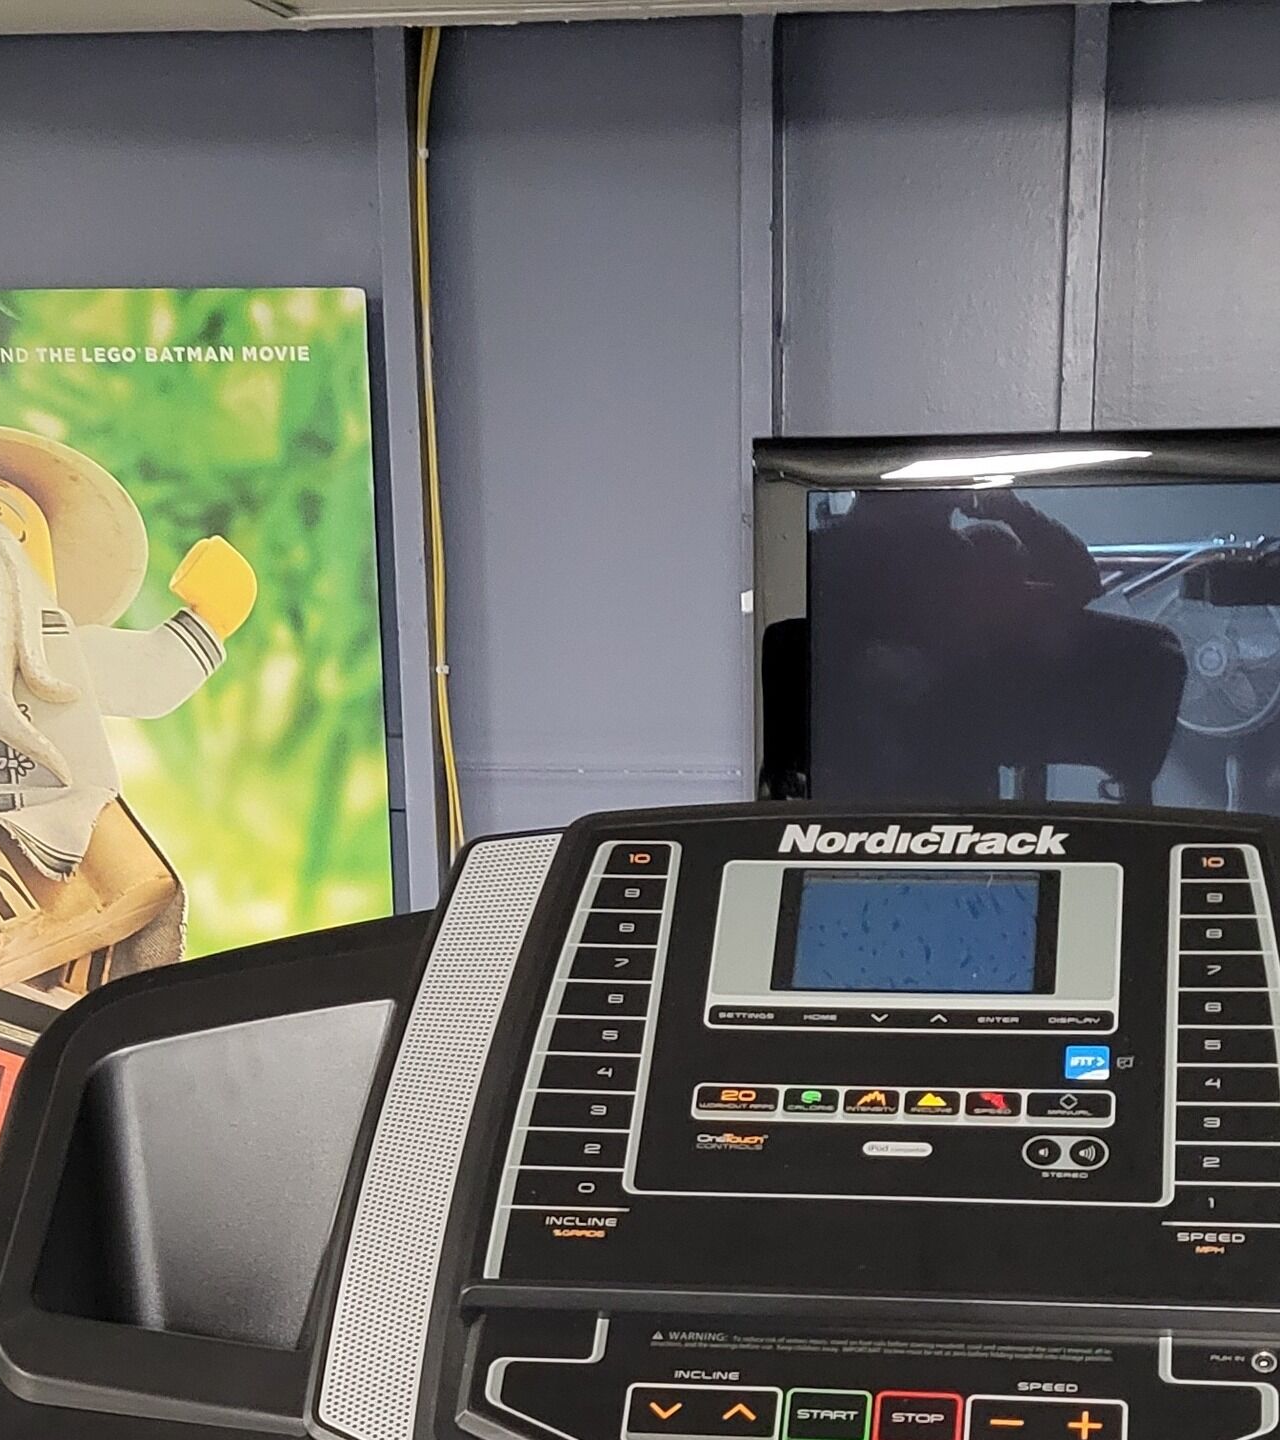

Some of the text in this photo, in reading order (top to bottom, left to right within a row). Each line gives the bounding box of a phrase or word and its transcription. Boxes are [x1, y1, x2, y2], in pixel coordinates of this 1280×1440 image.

[35, 347, 76, 364] THE
[145, 346, 235, 363] BATMAN
[241, 345, 310, 362] MOVIE
[778, 824, 1069, 855] NordicTrack
[629, 853, 650, 864] 10
[1201, 856, 1225, 868] 10
[613, 957, 630, 968] 7
[1206, 964, 1222, 976] 7
[718, 1011, 775, 1020] SETTINGS
[803, 1013, 838, 1021] HOME
[976, 1016, 1020, 1024] ENTER
[1047, 1016, 1101, 1024] DISPLAY
[601, 1030, 619, 1040] 5
[596, 1067, 613, 1078] 4
[1204, 1078, 1221, 1089] 4
[720, 1089, 757, 1102] 20
[589, 1104, 607, 1116] 3
[698, 1102, 748, 1110] WORKOUT
[845, 1105, 898, 1113] INTENSITY
[1203, 1117, 1221, 1128] 3
[583, 1143, 601, 1154] 2
[1202, 1156, 1220, 1168] 2
[1041, 1171, 1089, 1179] STEREO
[577, 1182, 595, 1193] 0
[1207, 1197, 1215, 1208] 1
[545, 1215, 618, 1227] INCLINE
[1176, 1232, 1246, 1244] SPEED
[674, 1369, 741, 1382] INCLINE
[1017, 1380, 1079, 1393] SPEED
[796, 1408, 859, 1423] START
[891, 1411, 946, 1425] STOP
